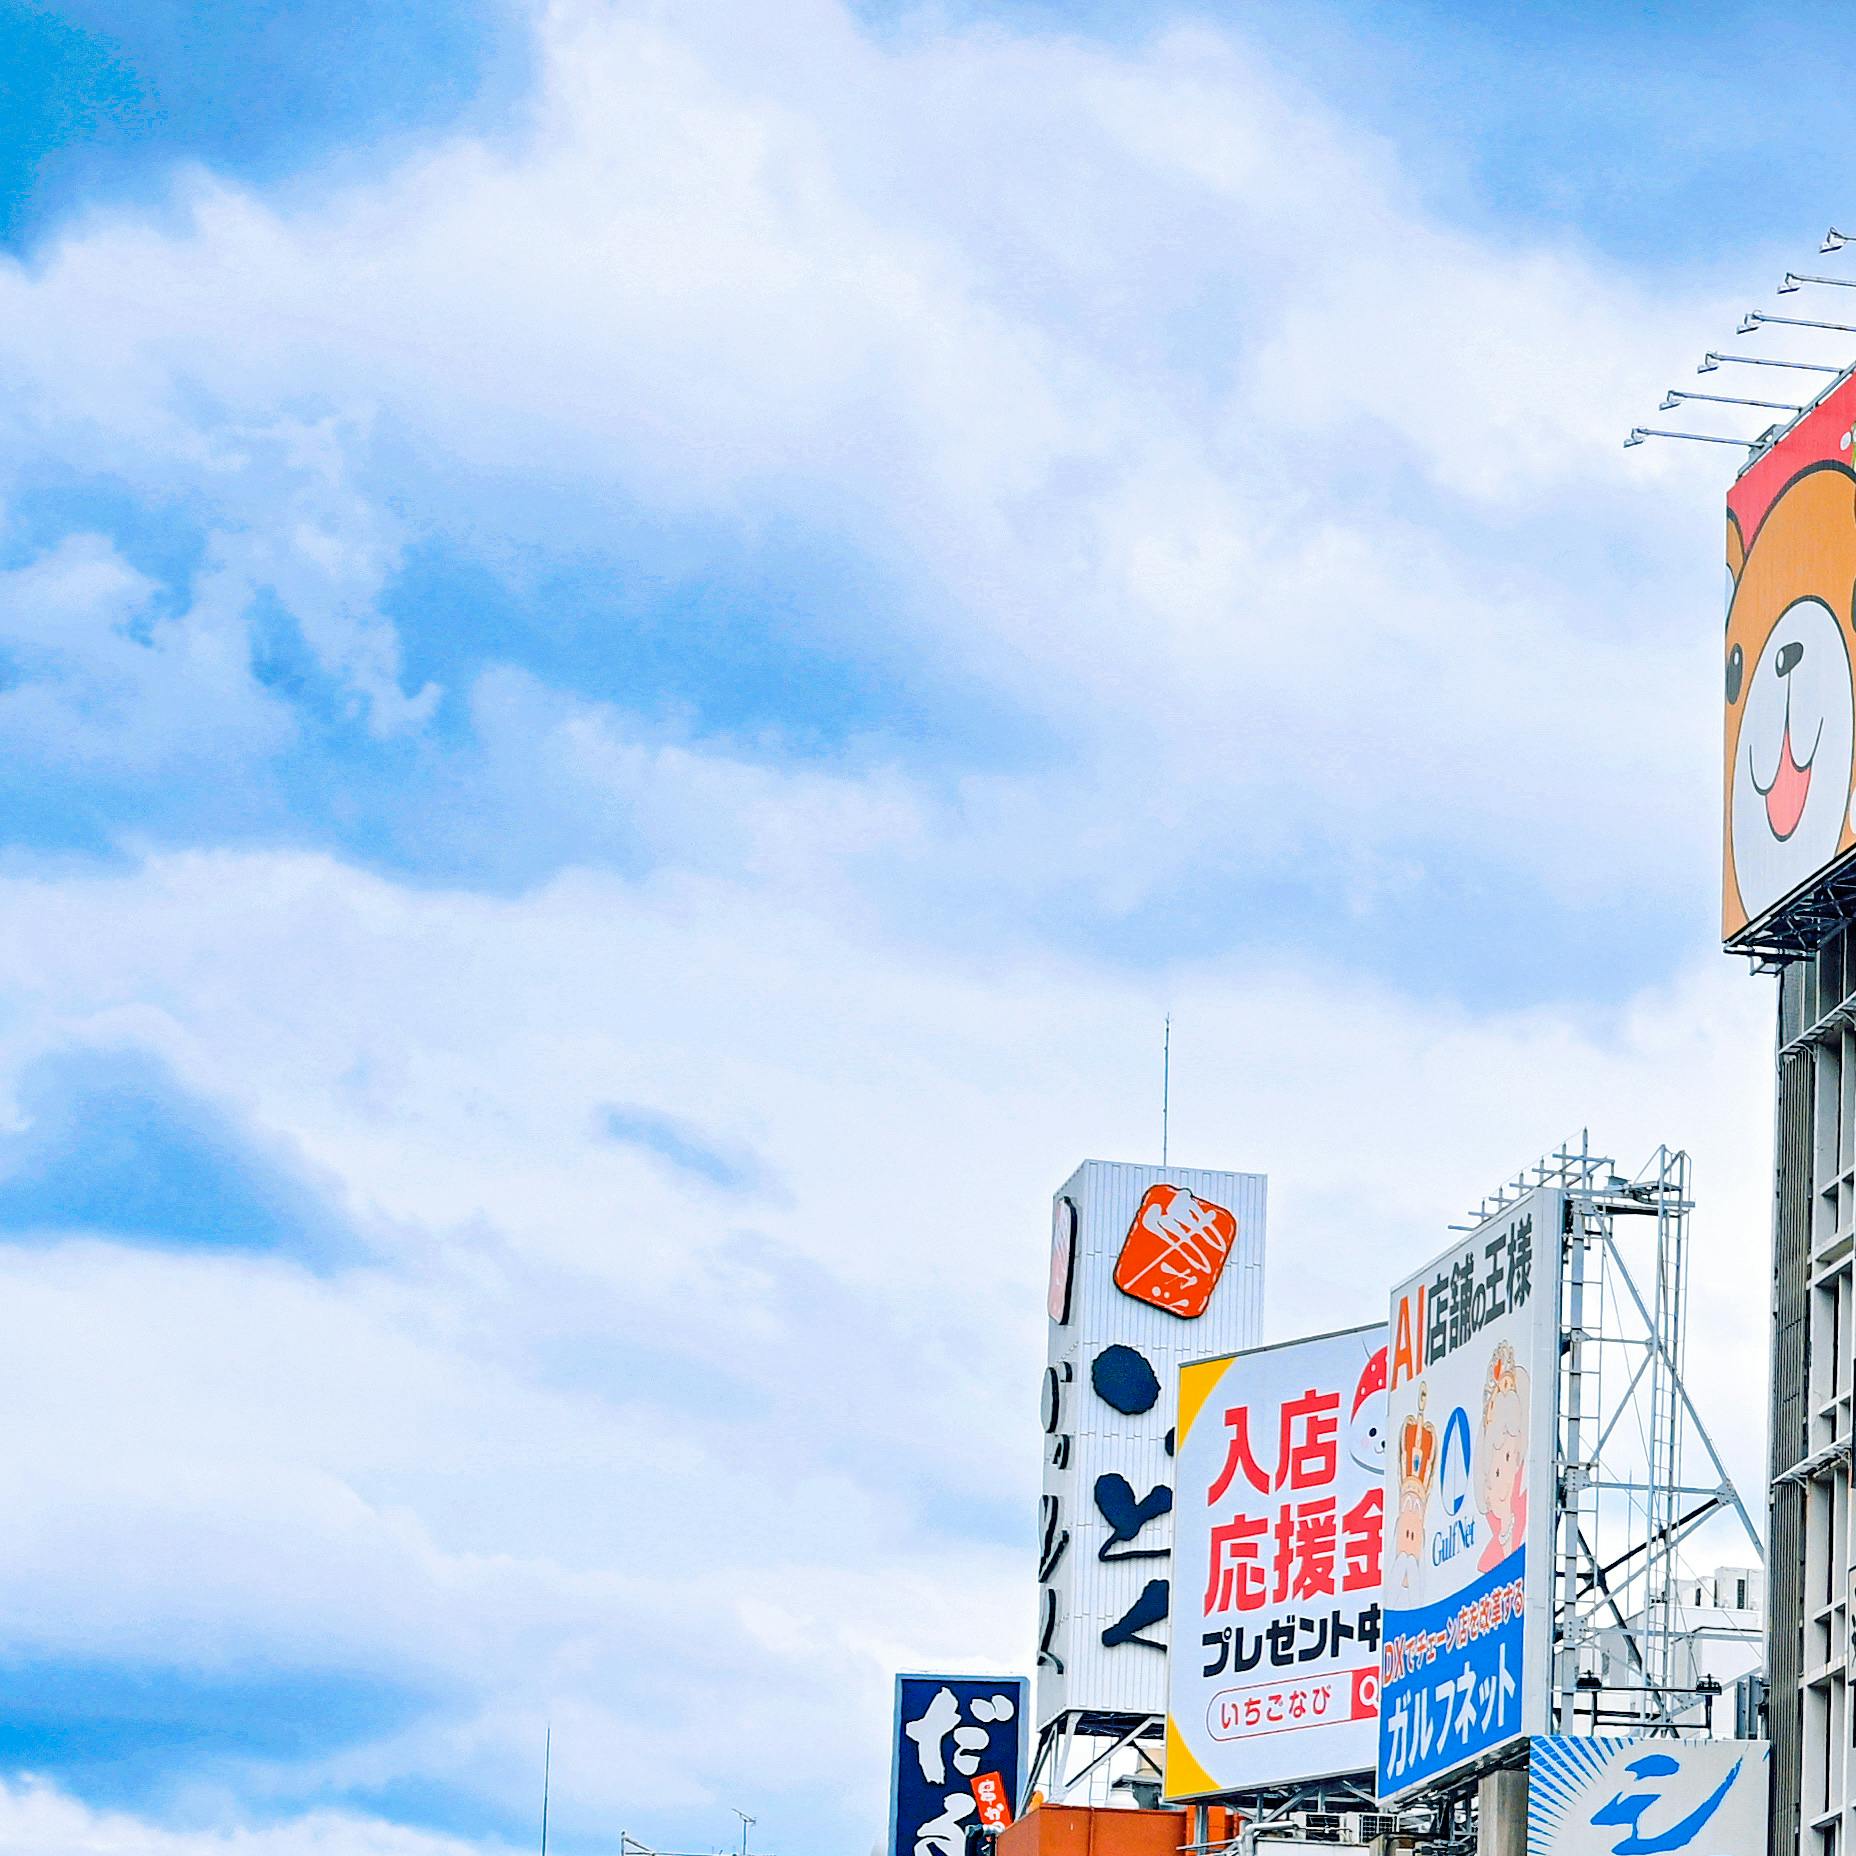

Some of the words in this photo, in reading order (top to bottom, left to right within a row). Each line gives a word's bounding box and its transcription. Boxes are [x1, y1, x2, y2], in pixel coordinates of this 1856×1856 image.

[1391, 1213, 1533, 1392] AI店舗の王様
[1207, 1389, 1340, 1507] 入店
[1205, 1489, 1384, 1618] 応援金
[1383, 1580, 1525, 1689] DXでチェーン店を改革する
[1220, 1684, 1333, 1730] いちごなび
[1386, 1642, 1517, 1780] ガルフネット
